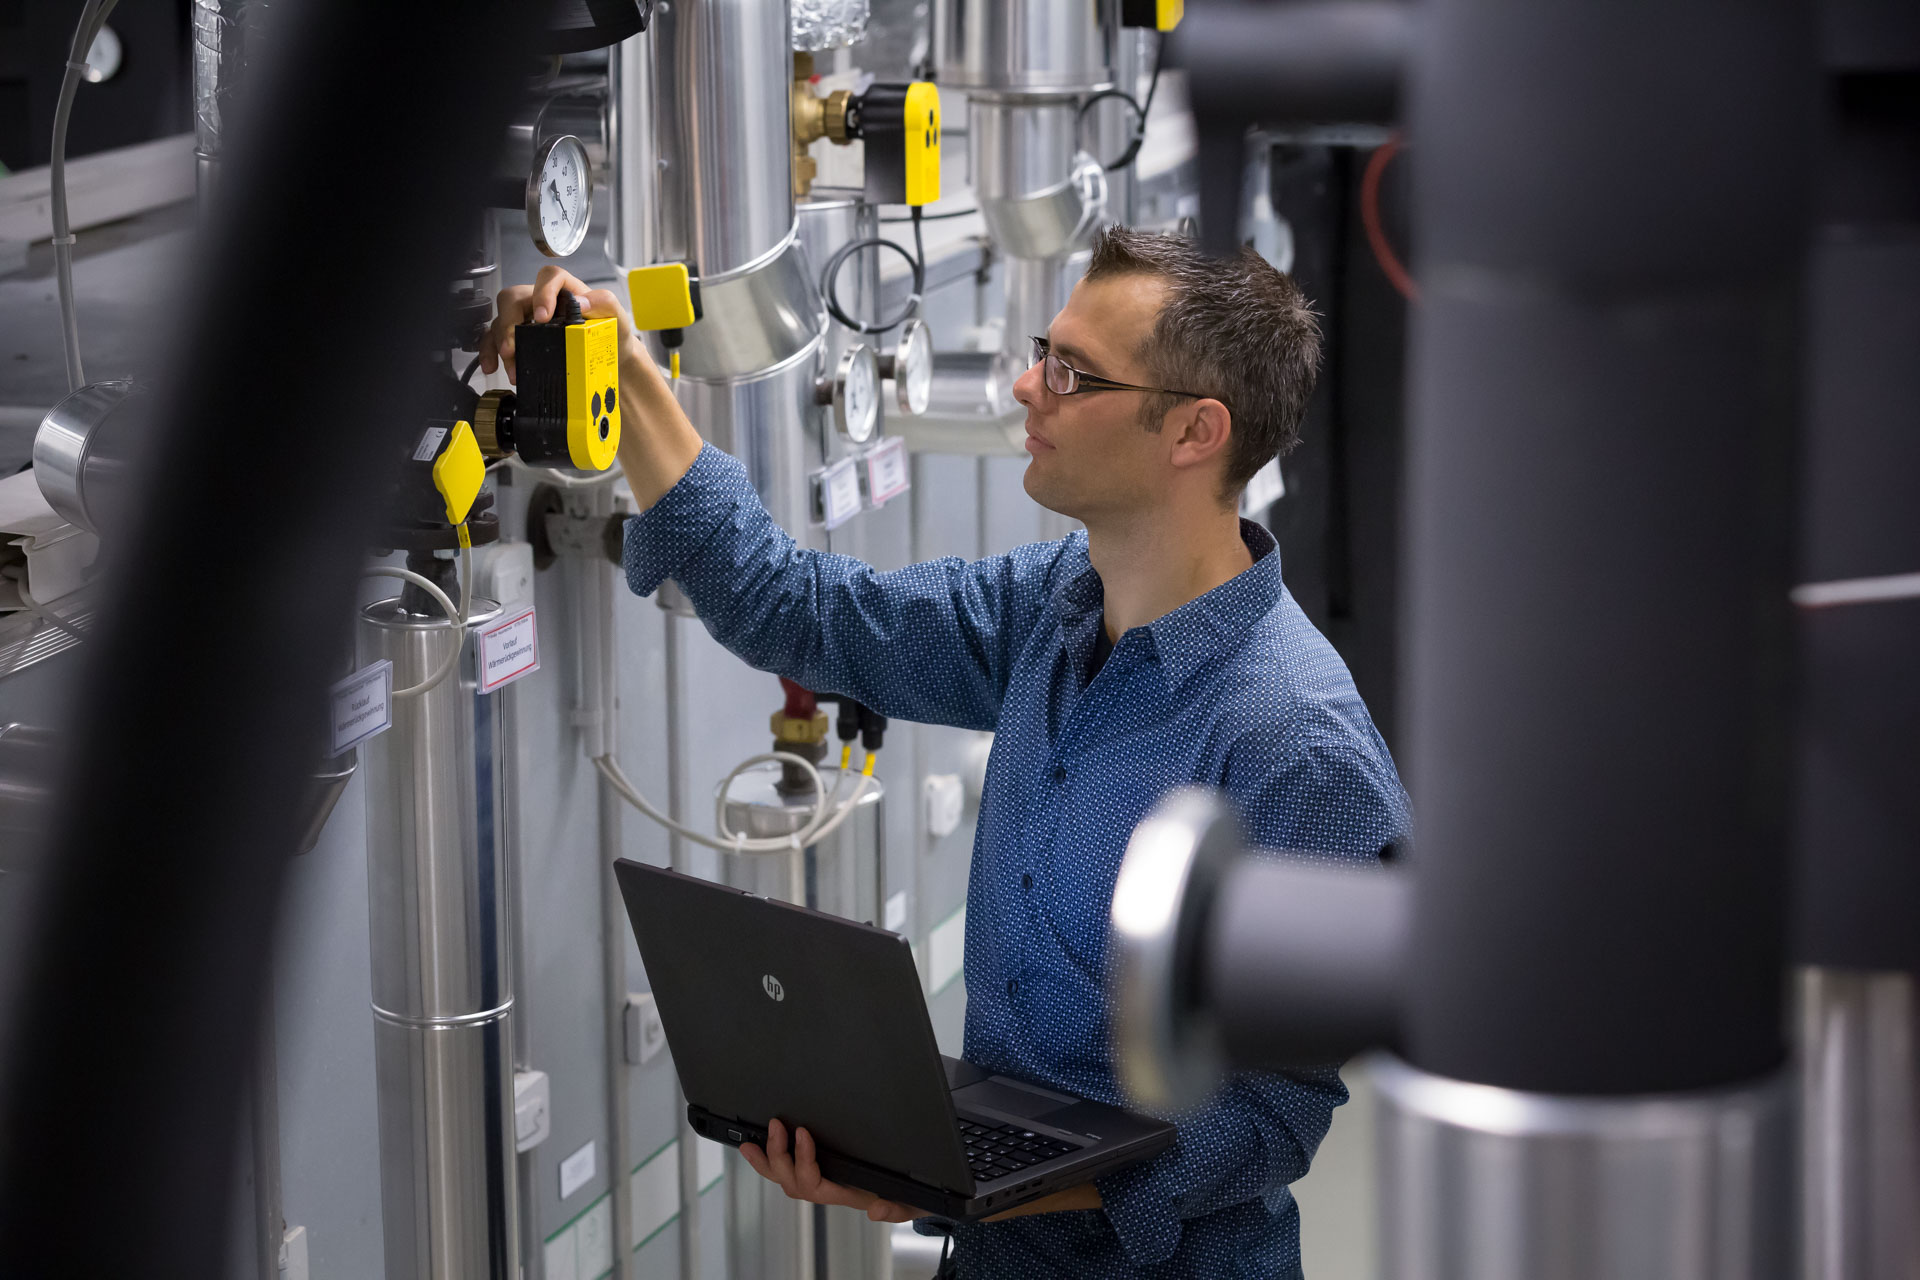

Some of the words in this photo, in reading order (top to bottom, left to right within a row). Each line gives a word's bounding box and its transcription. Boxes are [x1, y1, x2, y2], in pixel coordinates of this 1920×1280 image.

[552, 157, 558, 168] 30
[561, 165, 568, 176] 40
[566, 185, 573, 196] 50
[502, 635, 518, 650] Vorlauf
[766, 974, 783, 1001] hp
